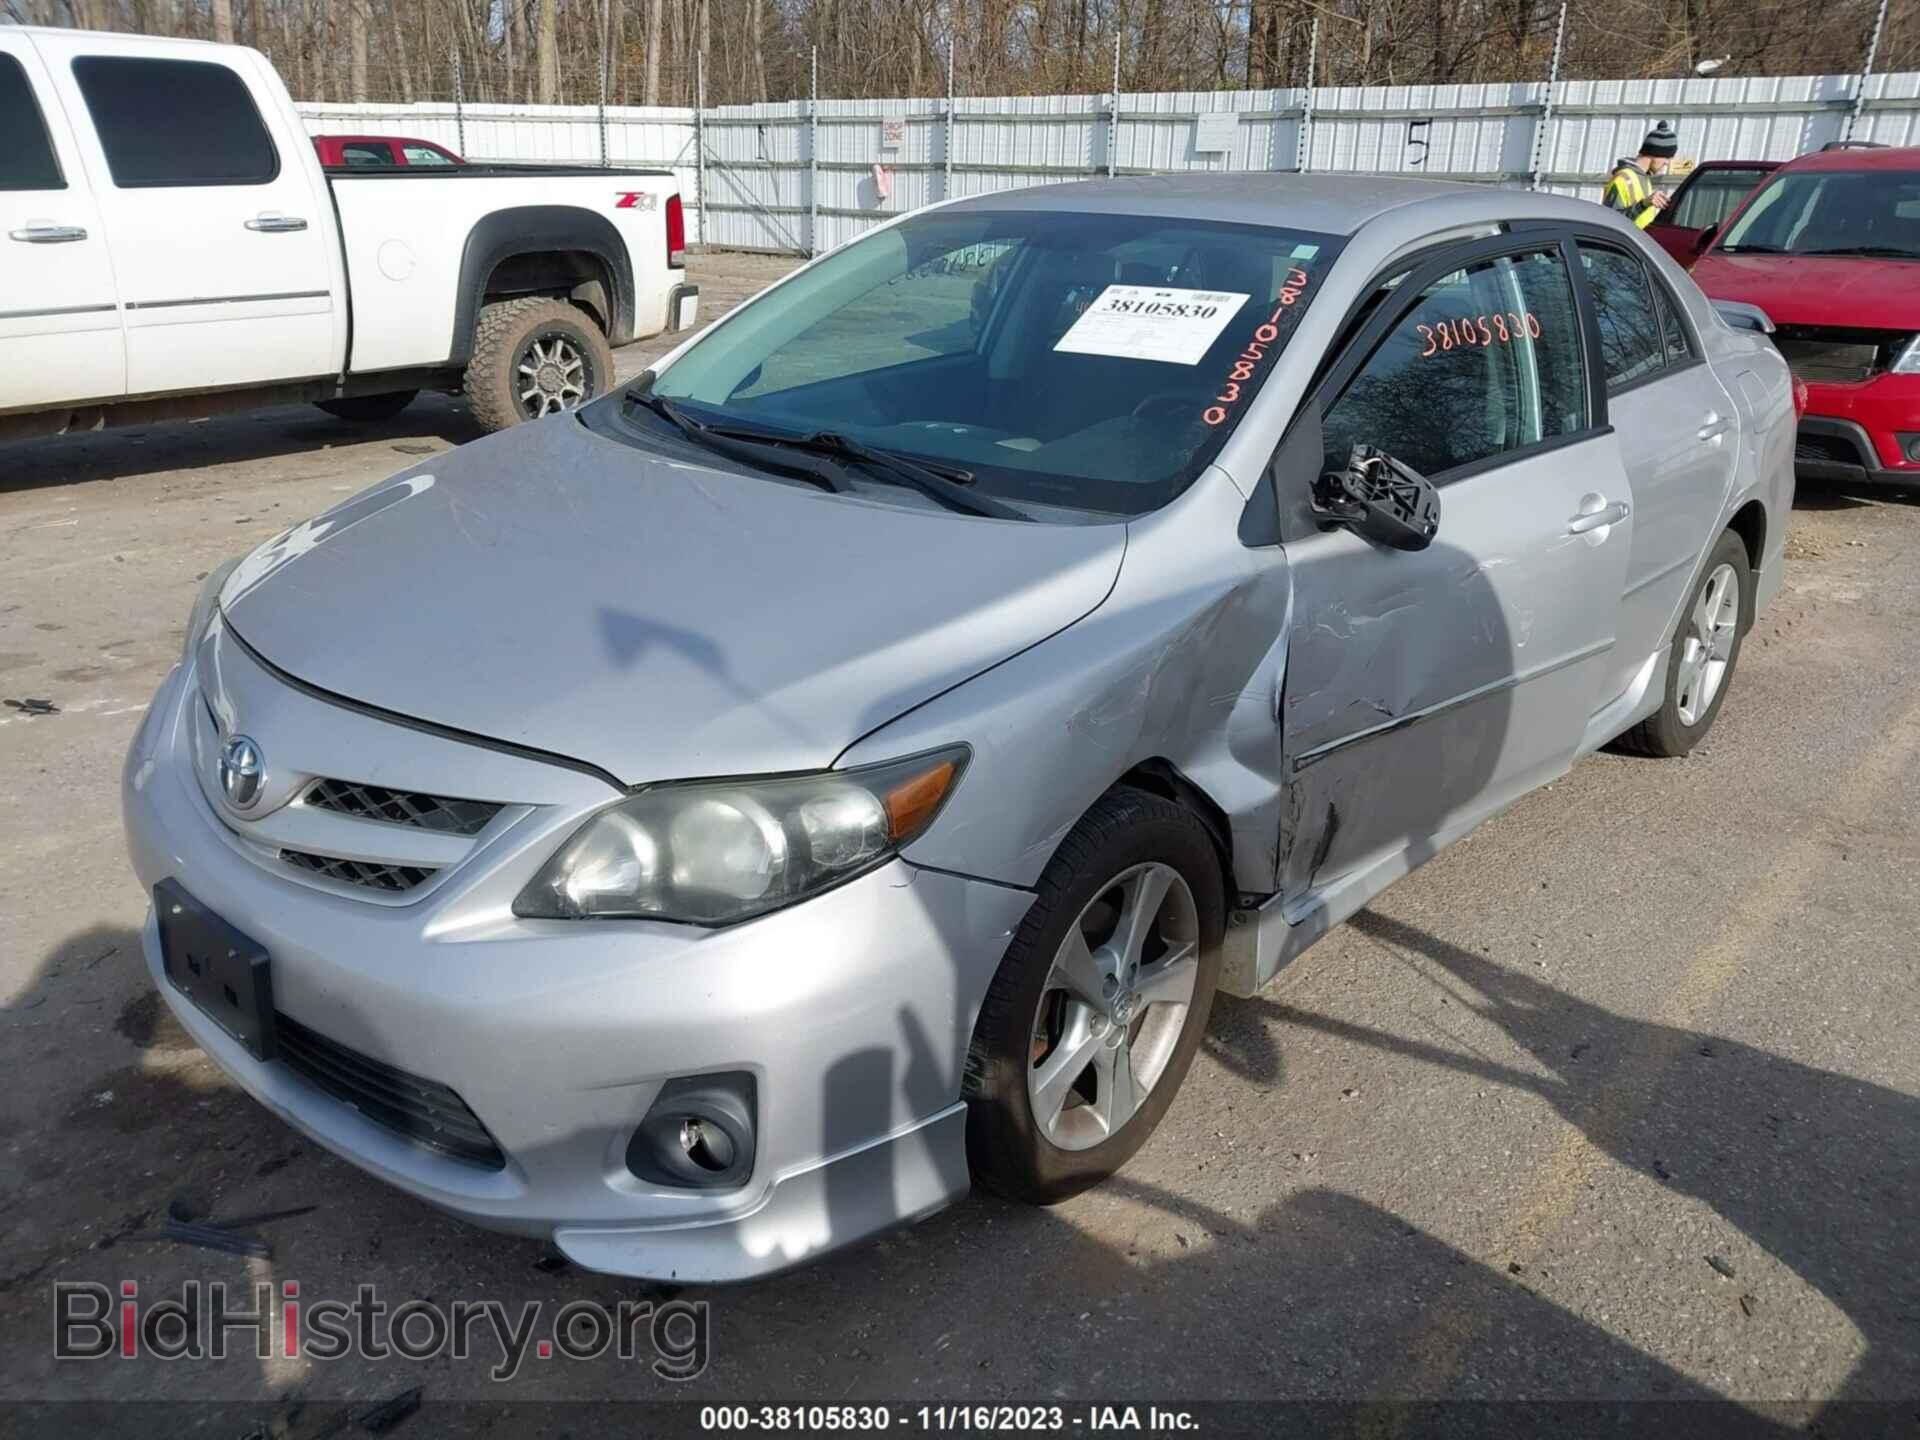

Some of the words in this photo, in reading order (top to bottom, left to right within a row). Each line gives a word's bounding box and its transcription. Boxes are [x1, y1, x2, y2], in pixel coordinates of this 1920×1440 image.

[884, 131, 905, 141] ZONE
[1408, 118, 1433, 165] 5
[1103, 299, 1218, 319] 38105830
[1203, 267, 1307, 425] 38105830
[1416, 312, 1540, 356] 38105830
